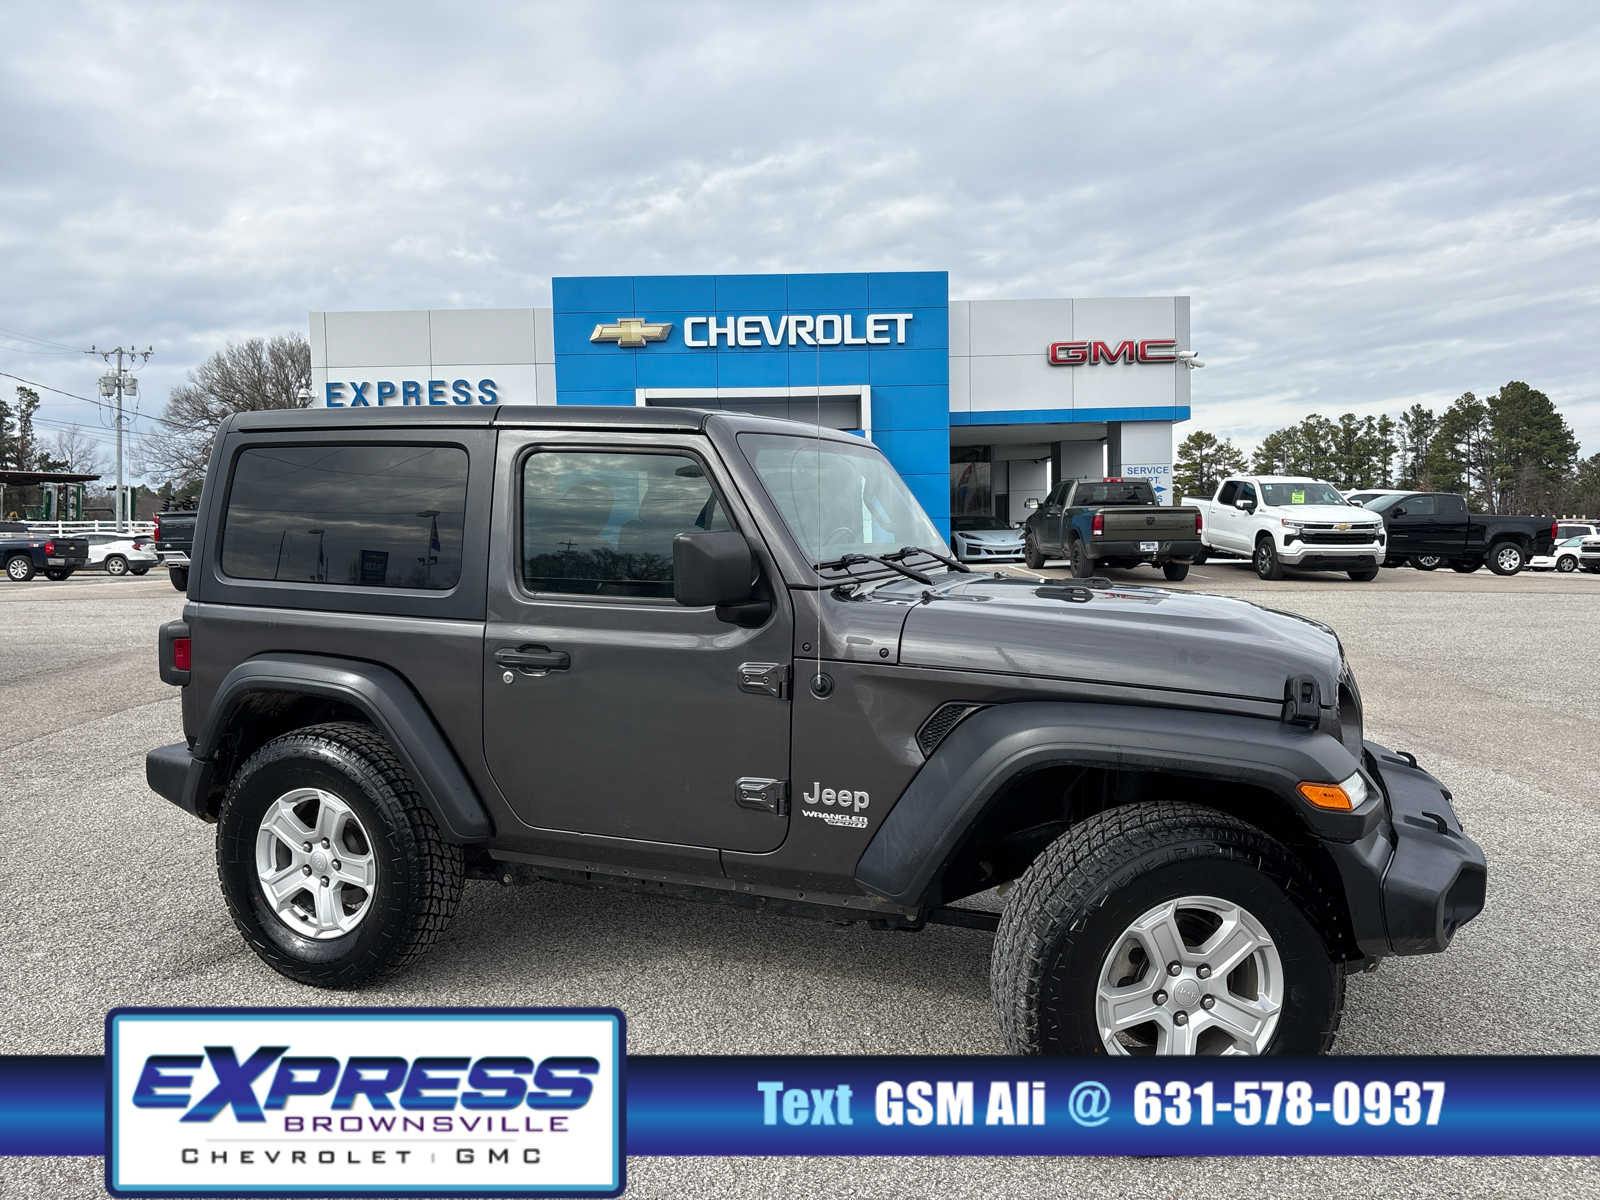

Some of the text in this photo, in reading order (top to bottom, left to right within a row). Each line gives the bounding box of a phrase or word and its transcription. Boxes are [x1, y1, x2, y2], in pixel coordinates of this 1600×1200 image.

[683, 313, 913, 347] CHEVROLET
[1048, 339, 1176, 365] GMC
[325, 378, 499, 408] EXPRESS
[1127, 466, 1169, 475] SERVICE
[803, 781, 870, 812] Jeep
[802, 809, 868, 823] WRANGLER
